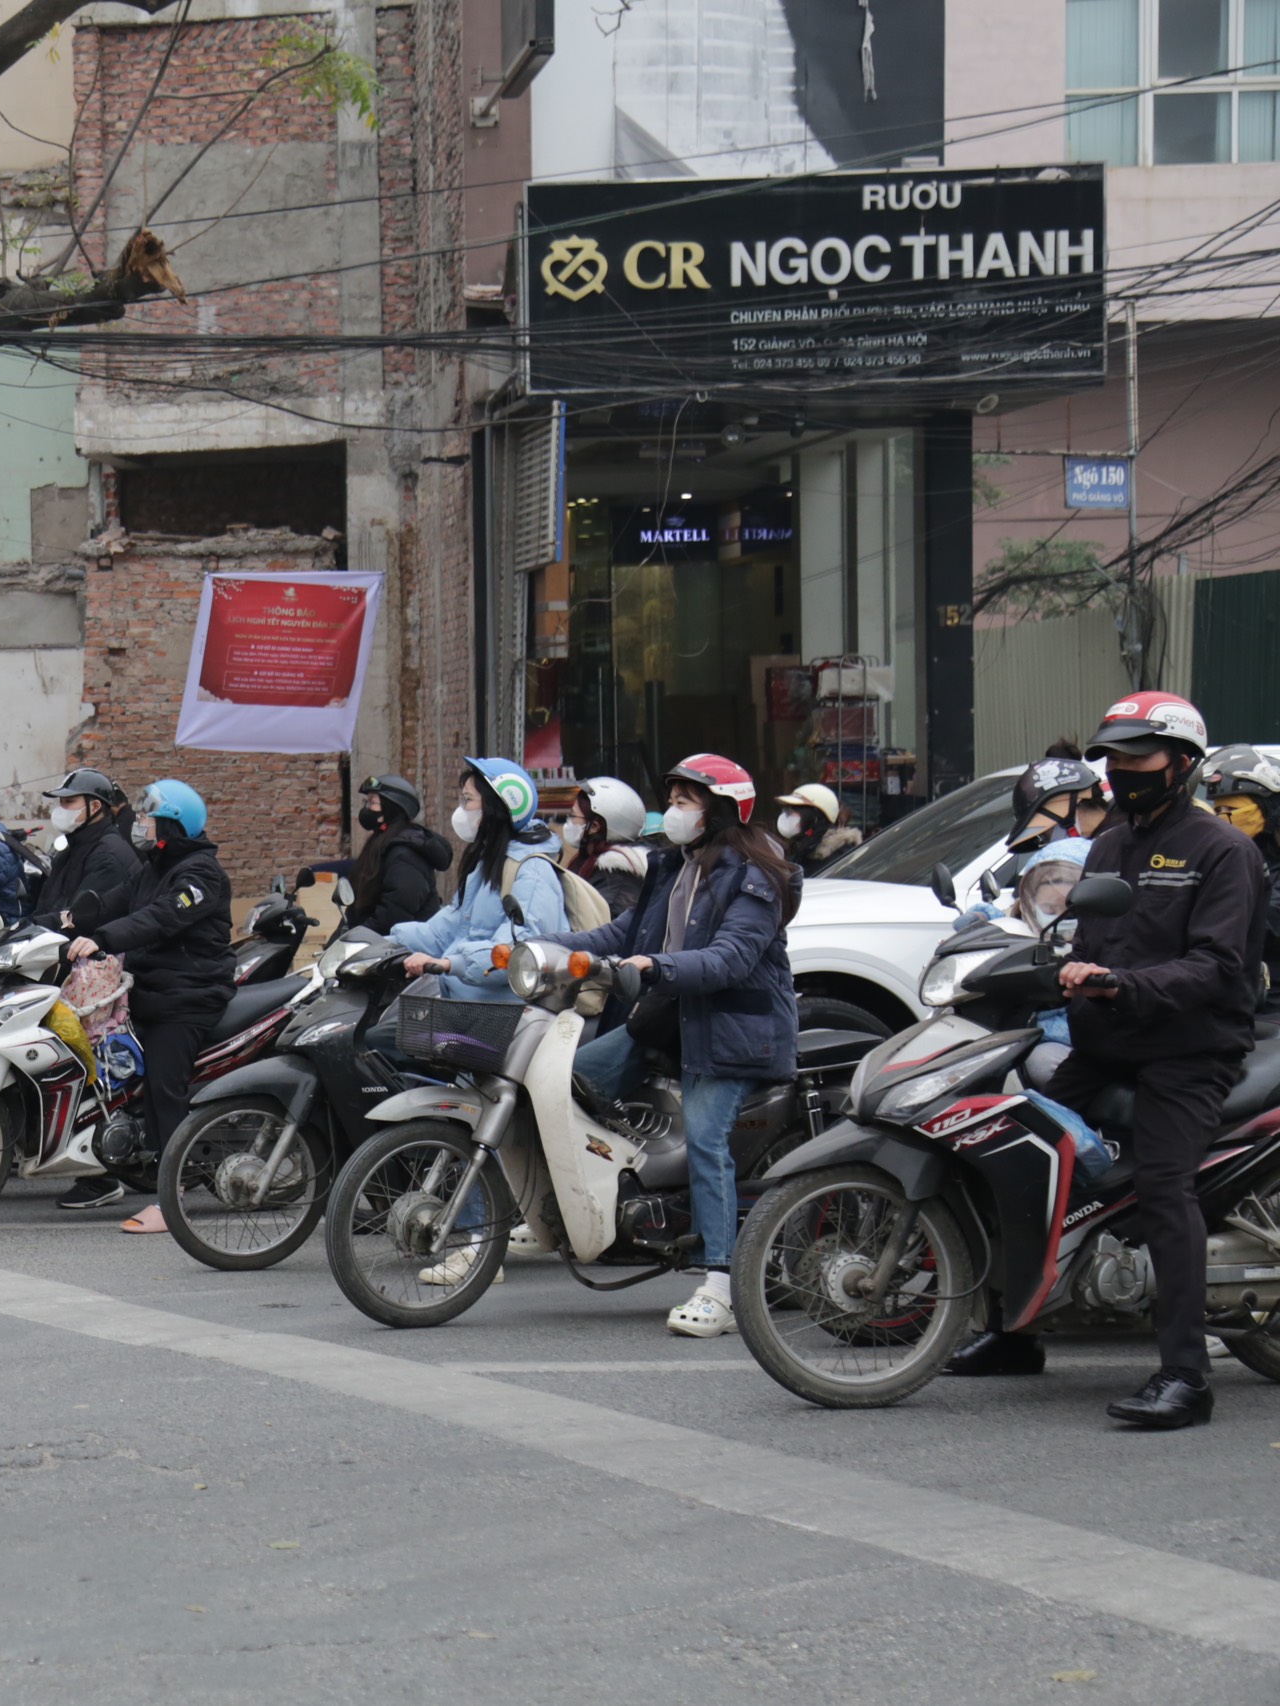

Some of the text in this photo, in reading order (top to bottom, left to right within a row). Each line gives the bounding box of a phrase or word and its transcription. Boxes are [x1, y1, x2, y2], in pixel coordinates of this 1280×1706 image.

[623, 239, 711, 290] CR
[729, 229, 1095, 300] NGỌC THANH
[732, 337, 757, 351] 152
[1101, 464, 1125, 487] 150
[640, 527, 710, 544] MARTELL
[936, 603, 973, 628] 152
